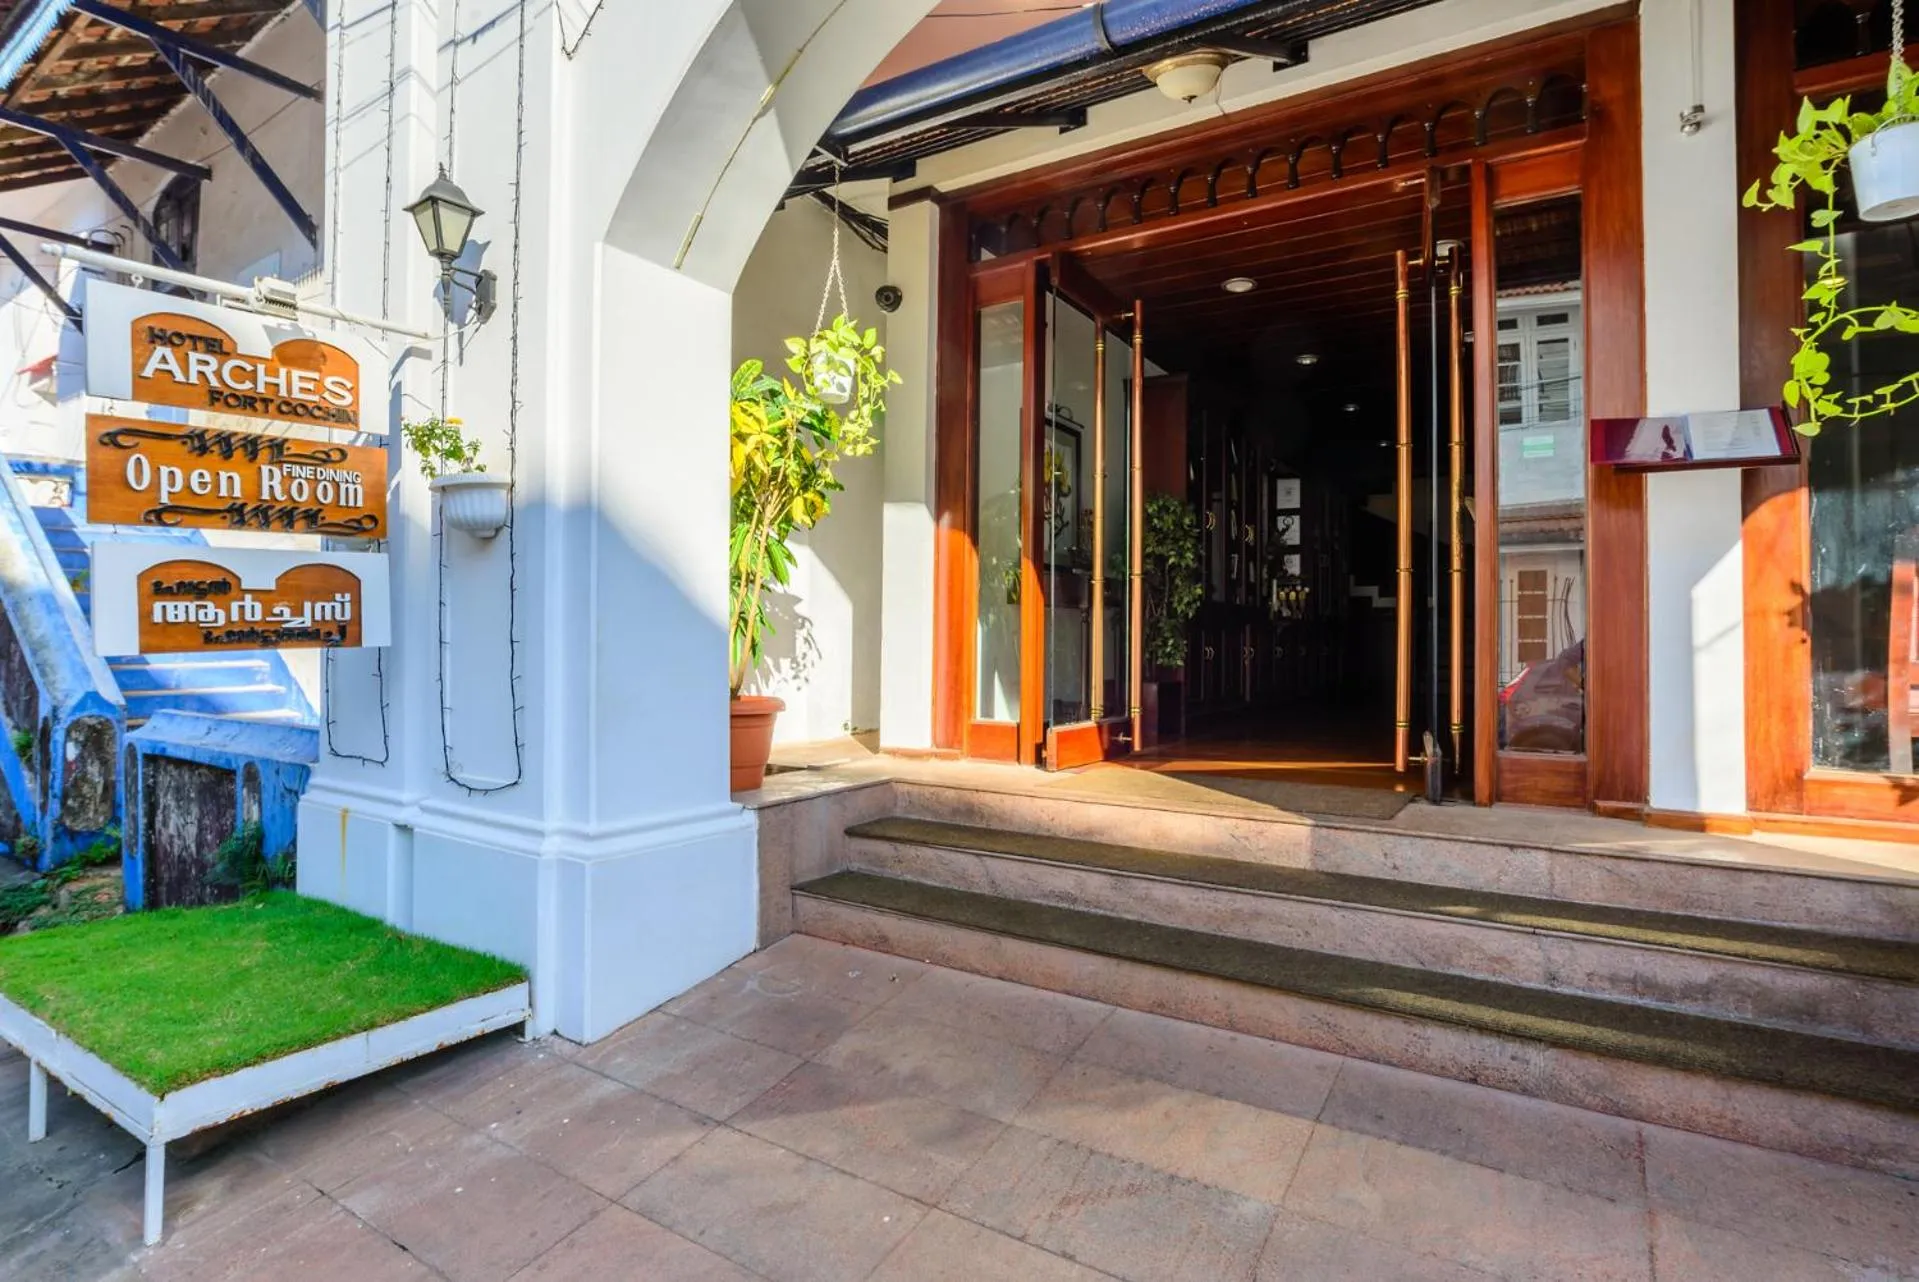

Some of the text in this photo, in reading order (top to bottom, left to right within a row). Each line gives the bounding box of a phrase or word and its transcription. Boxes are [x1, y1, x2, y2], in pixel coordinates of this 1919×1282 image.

[146, 326, 230, 355] HOTEL
[139, 346, 354, 406] ARCHES
[207, 389, 359, 425] FORT COCHIN
[126, 453, 363, 508] Open Room
[282, 463, 362, 483] FINE DINING
